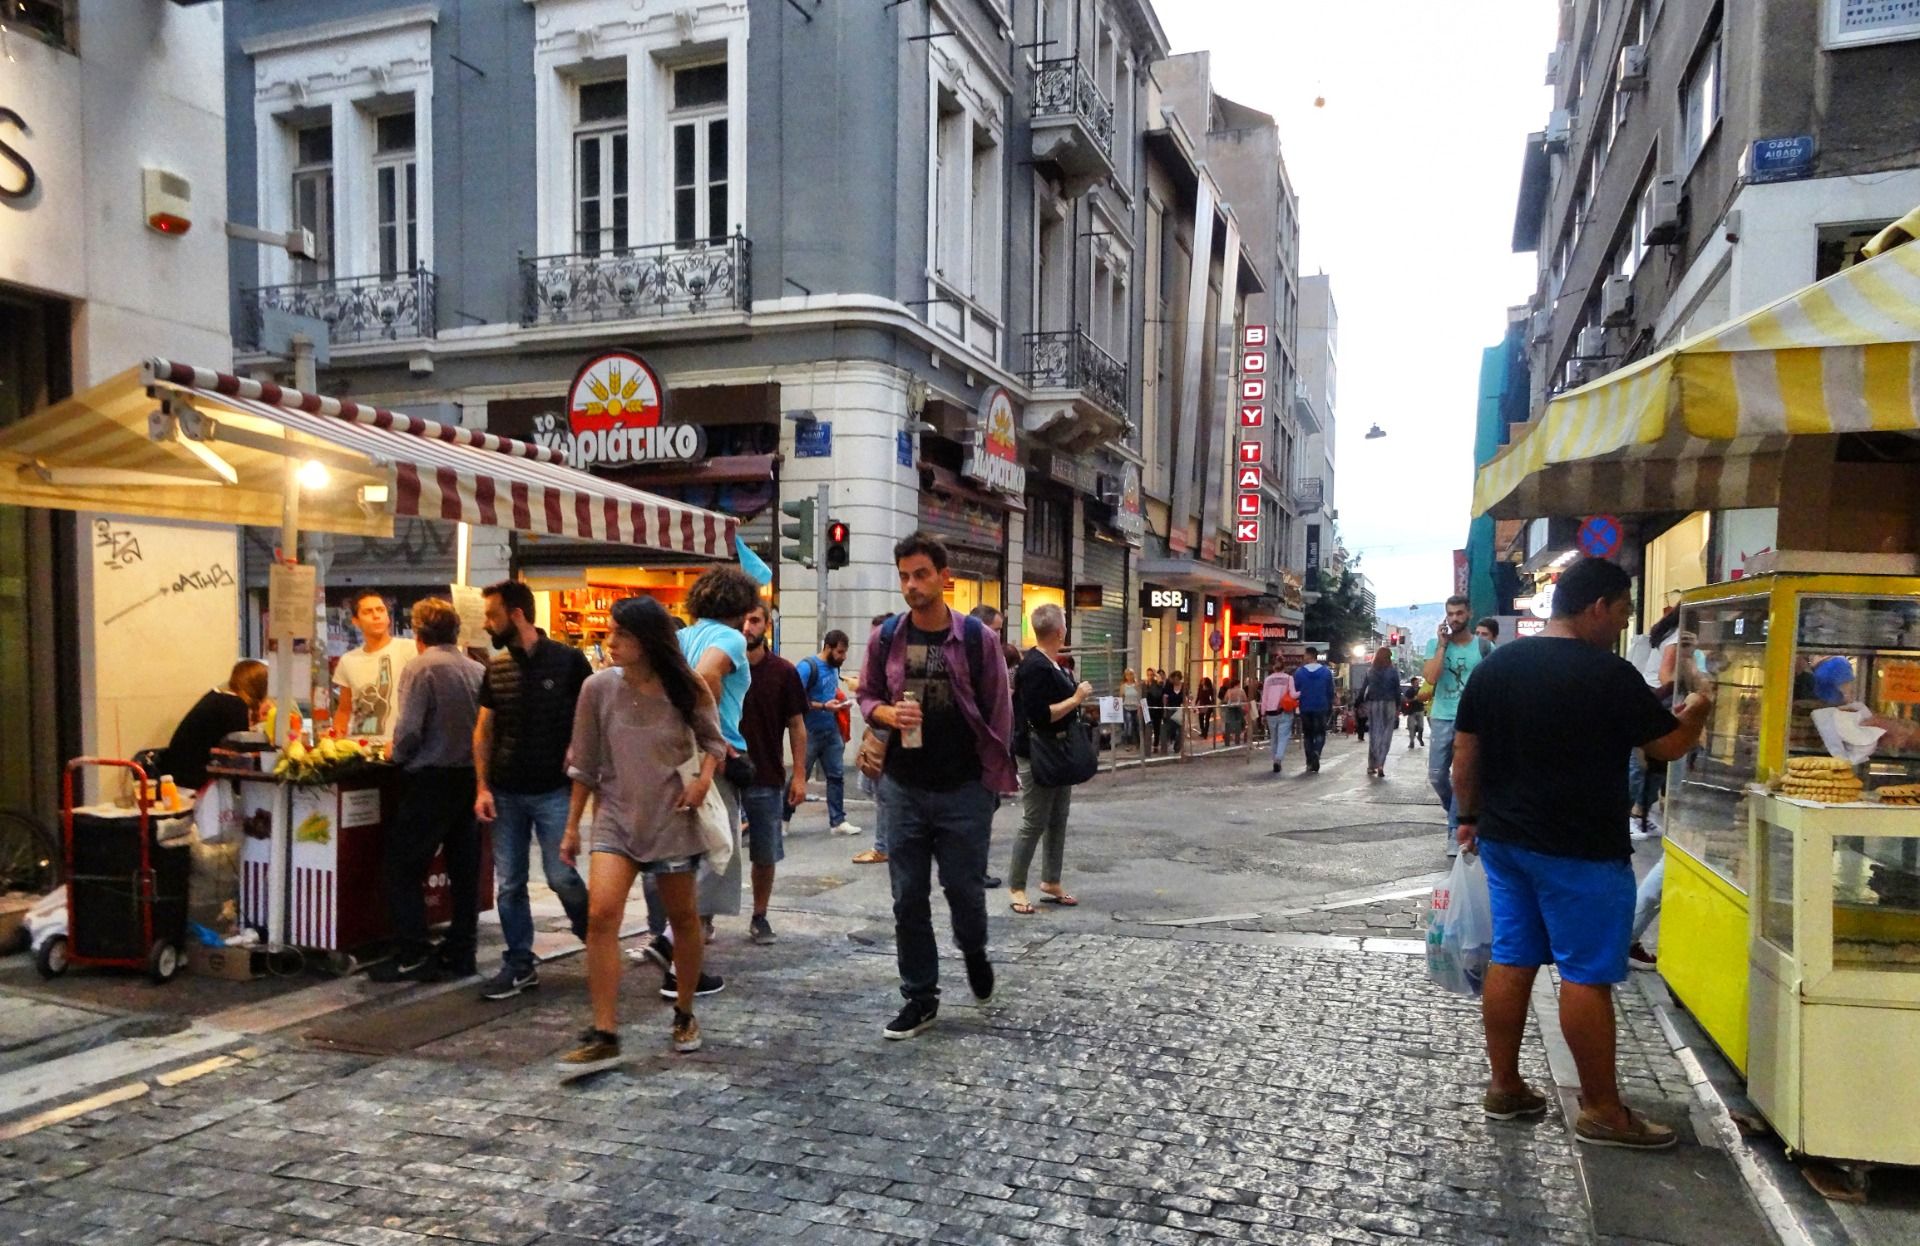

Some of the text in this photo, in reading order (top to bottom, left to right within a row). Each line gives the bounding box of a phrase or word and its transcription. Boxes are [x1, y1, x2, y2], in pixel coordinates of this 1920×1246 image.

[1238, 329, 1263, 538] BODY TALK
[1151, 590, 1183, 608] BSB
